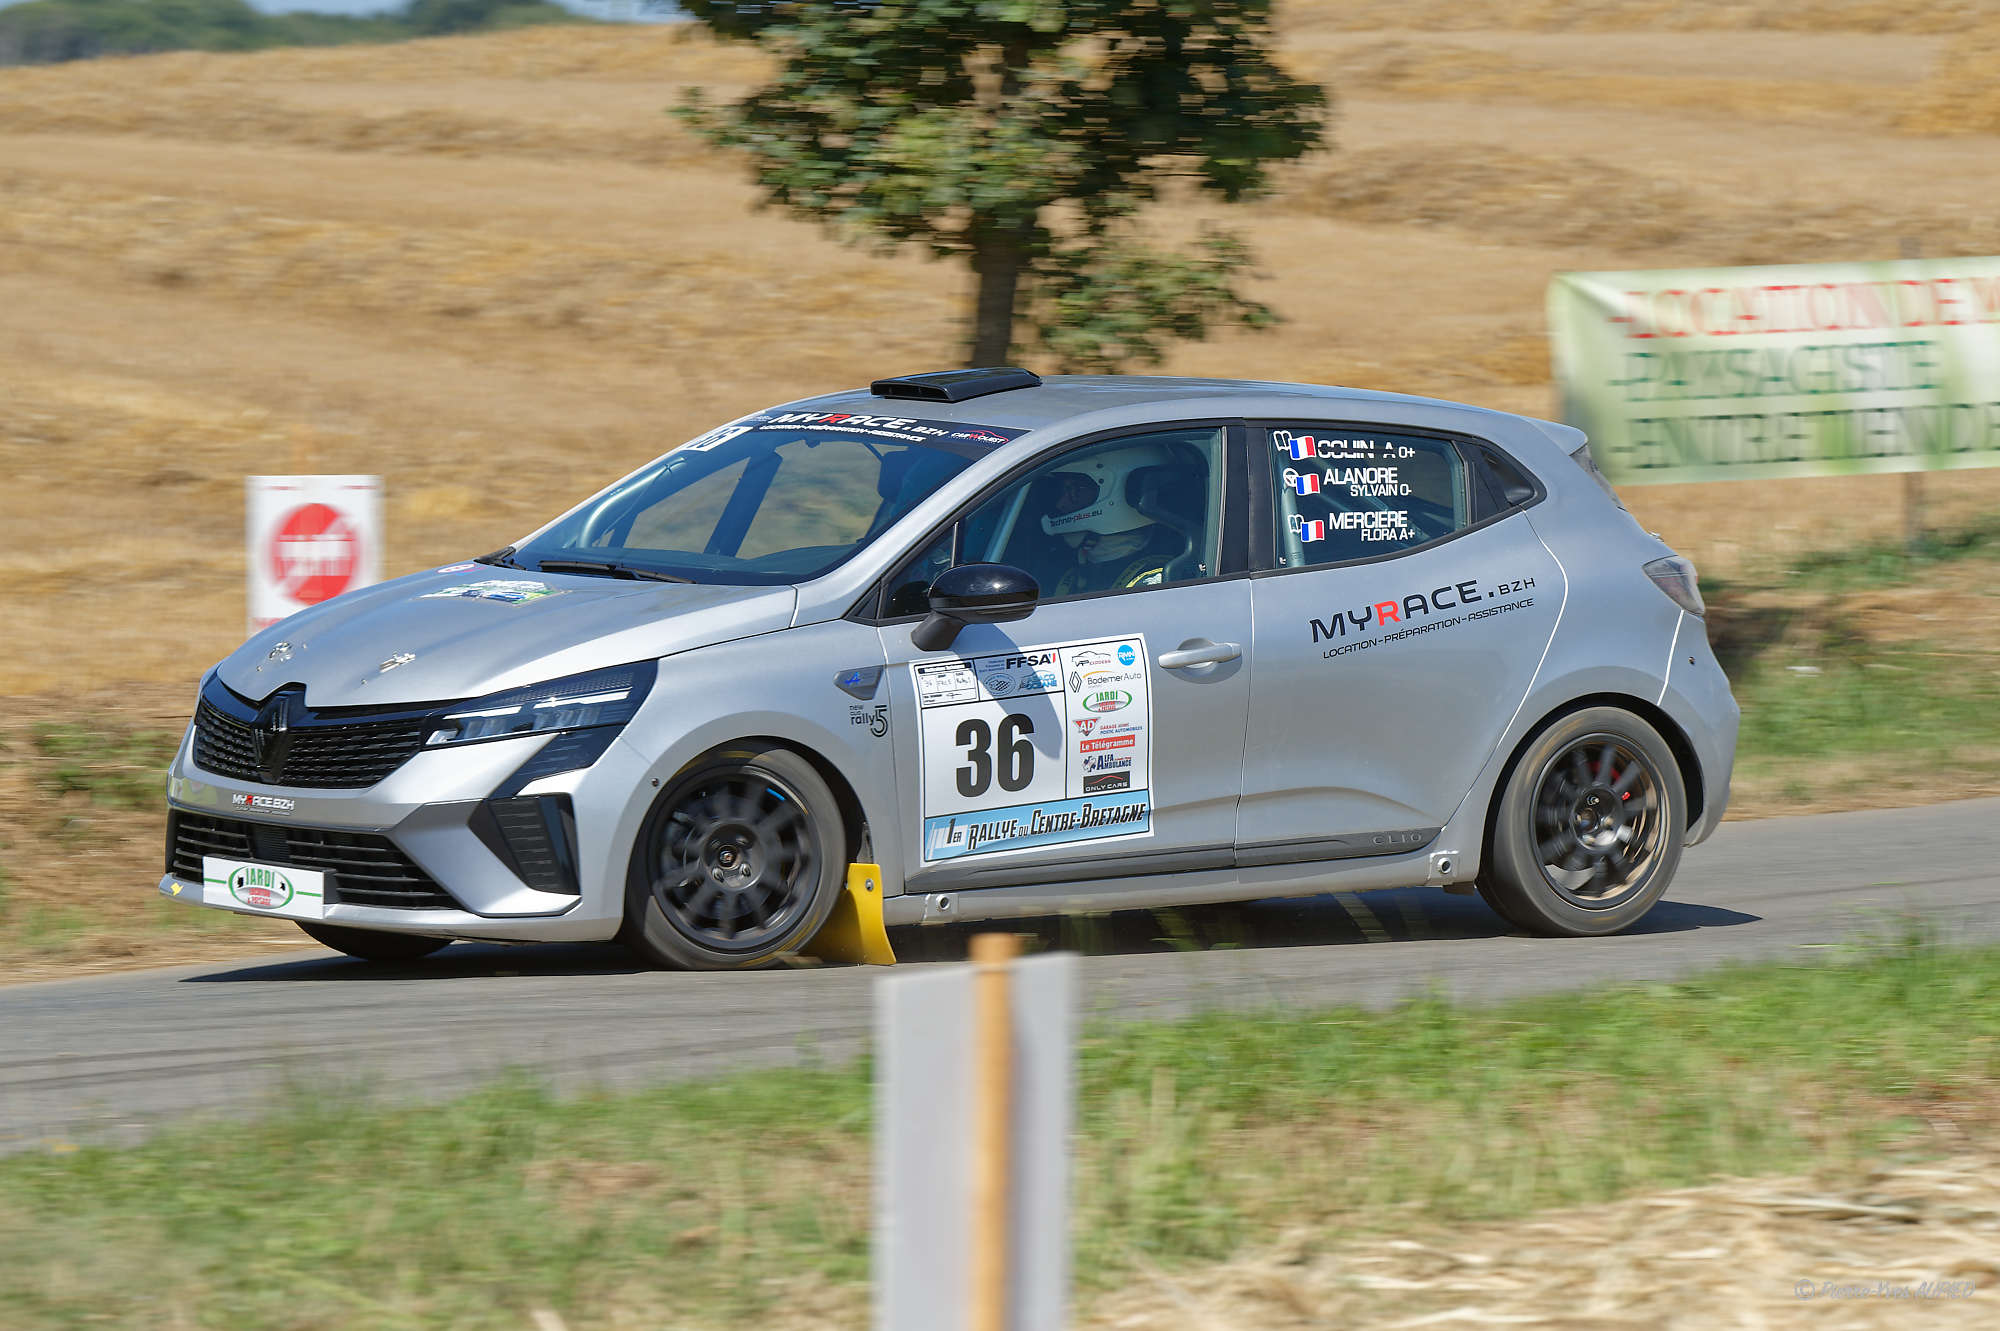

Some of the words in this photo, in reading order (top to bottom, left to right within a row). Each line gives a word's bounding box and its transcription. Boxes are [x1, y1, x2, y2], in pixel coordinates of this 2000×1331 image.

[1624, 340, 1939, 402] PAYSAGISTE
[768, 412, 949, 437] MYRACE.BZH
[1628, 404, 1943, 468] ENTRETIEN
[1323, 467, 1398, 485] ALANORE
[1350, 484, 1397, 497] SYLVAIN
[1329, 510, 1408, 530] MERCIERE
[1361, 528, 1397, 541] FLORA
[1399, 528, 1416, 541] A+
[1005, 653, 1051, 669] FFSA
[1096, 690, 1118, 702] JARDI
[1080, 719, 1095, 731] AD
[1081, 743, 1090, 751] Le
[1091, 738, 1134, 750] Télégramme
[954, 713, 1035, 798] 36
[967, 819, 1018, 850] RALLYE
[1018, 826, 1030, 838] DU
[1030, 803, 1147, 836] CENTRE-BRETAGNE
[1372, 833, 1422, 846] CLIO
[245, 867, 275, 889] JARDI
